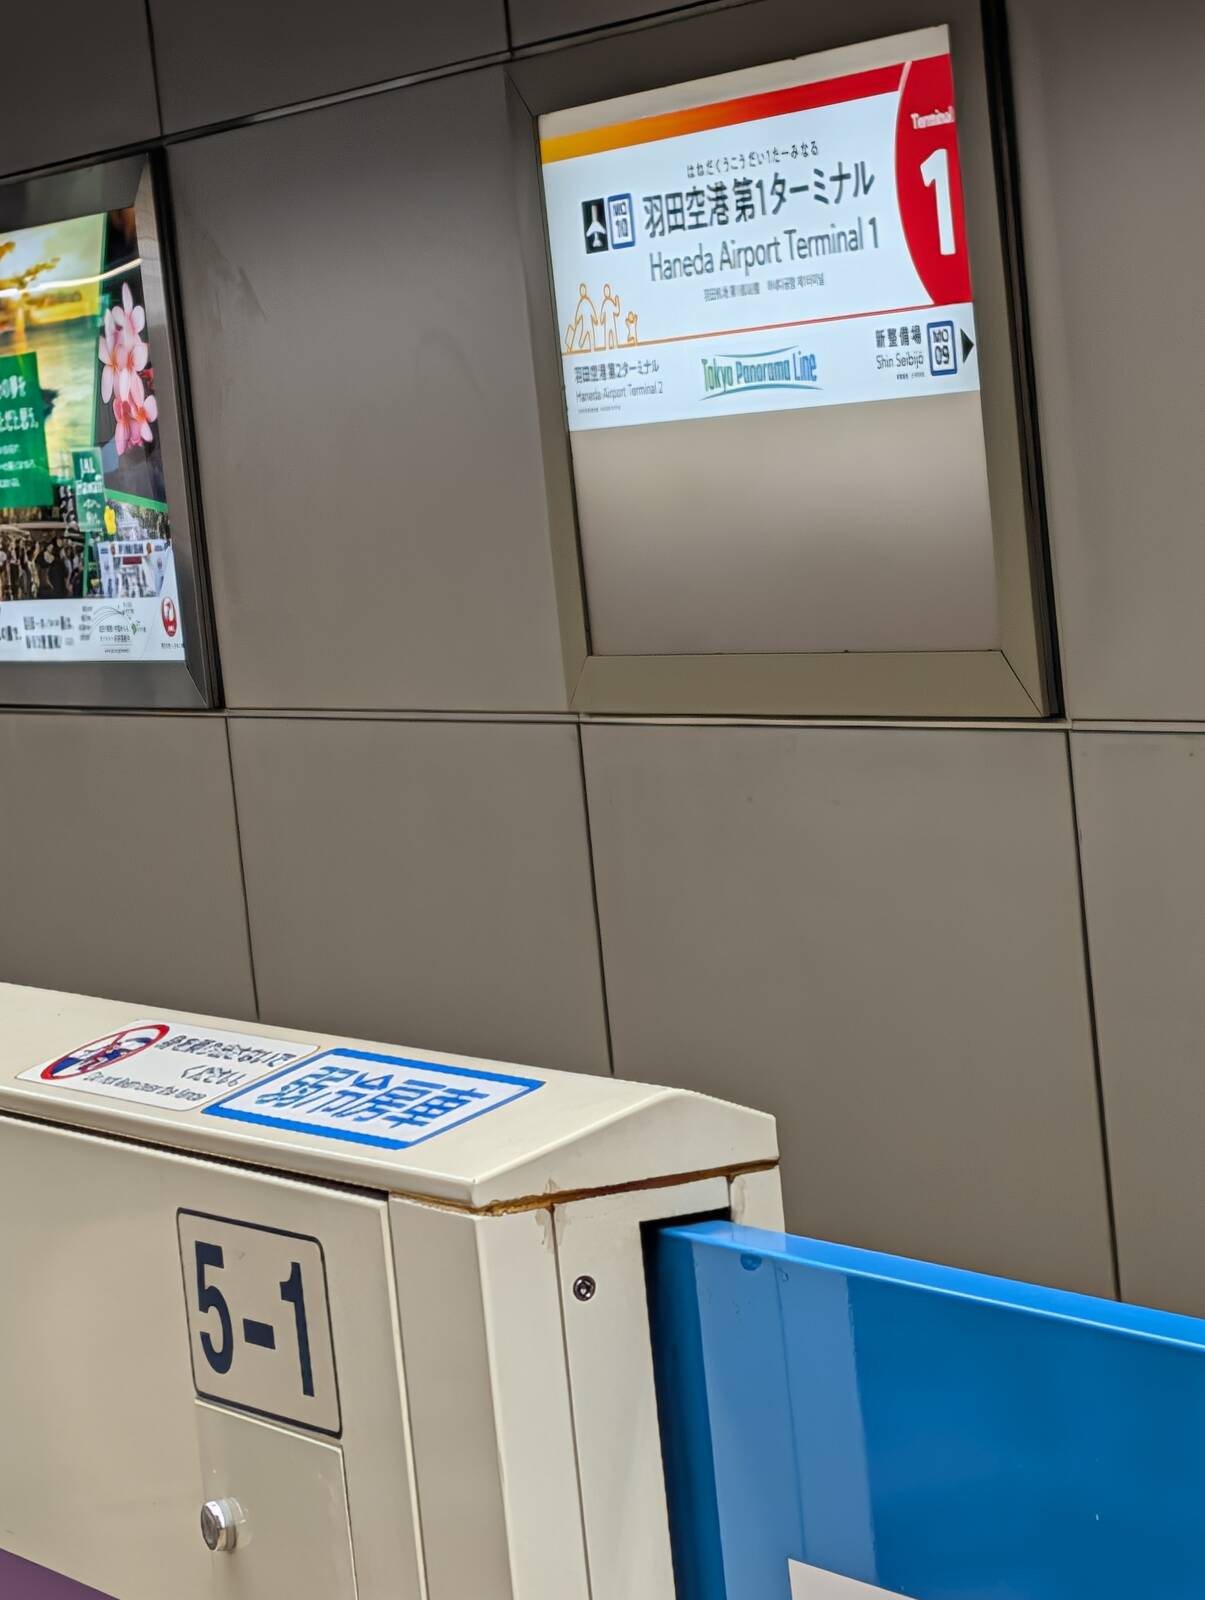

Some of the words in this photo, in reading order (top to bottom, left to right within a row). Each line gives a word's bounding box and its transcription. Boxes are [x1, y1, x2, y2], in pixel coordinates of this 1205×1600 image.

[642, 160, 875, 239] 羽田空港第1ターミナル
[920, 148, 956, 256] 1
[648, 242, 714, 282] Haneda
[719, 236, 782, 276] Airport
[784, 216, 865, 261] Terminal
[869, 216, 880, 249] 1
[875, 324, 922, 348] 新整備場
[932, 328, 949, 344] MO
[701, 357, 733, 392] Tokyo
[735, 358, 791, 384] Panorama
[792, 350, 818, 383] Line
[876, 354, 894, 370] Shin
[934, 345, 950, 365] 09
[575, 389, 602, 404] Haneda
[603, 386, 628, 402] Airport
[629, 381, 657, 397] Terminal
[658, 382, 664, 395] 2
[195, 1240, 315, 1398] 5-1
